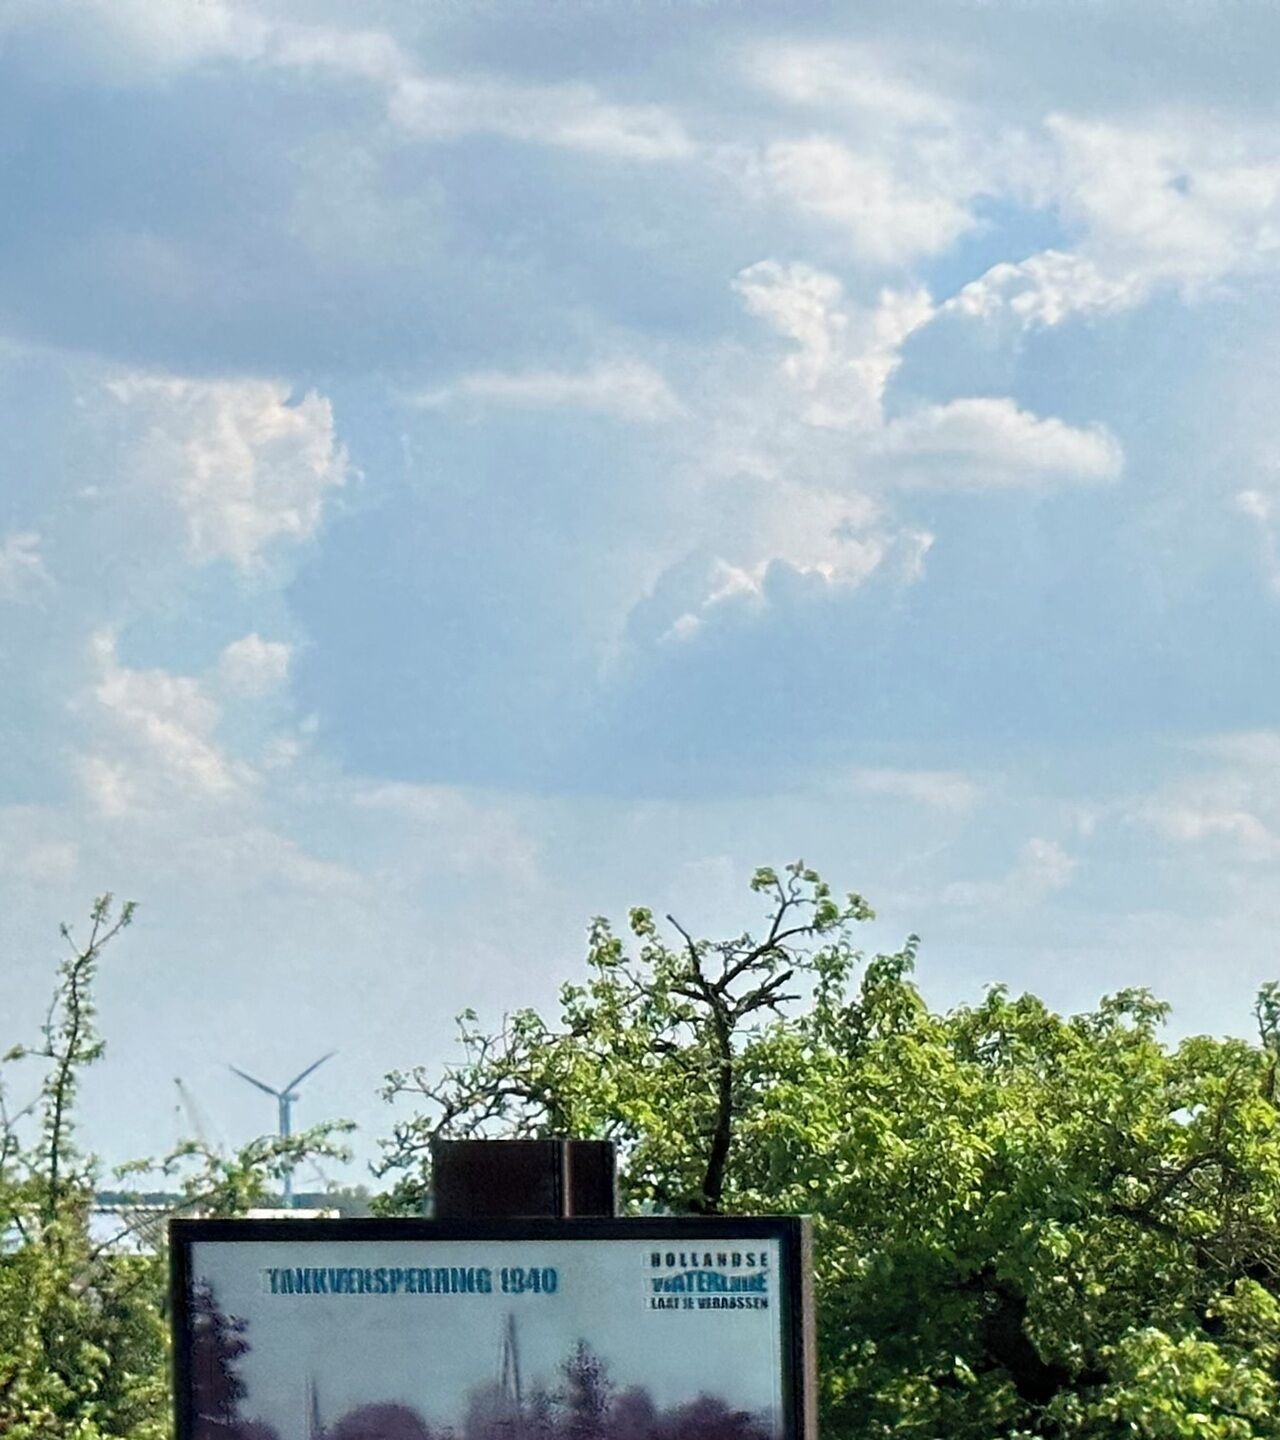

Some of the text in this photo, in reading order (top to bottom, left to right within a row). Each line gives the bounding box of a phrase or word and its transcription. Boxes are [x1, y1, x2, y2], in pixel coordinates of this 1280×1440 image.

[651, 1252, 768, 1267] HOLLANDSE
[267, 1267, 558, 1294] TANKVERSPERRING 1940
